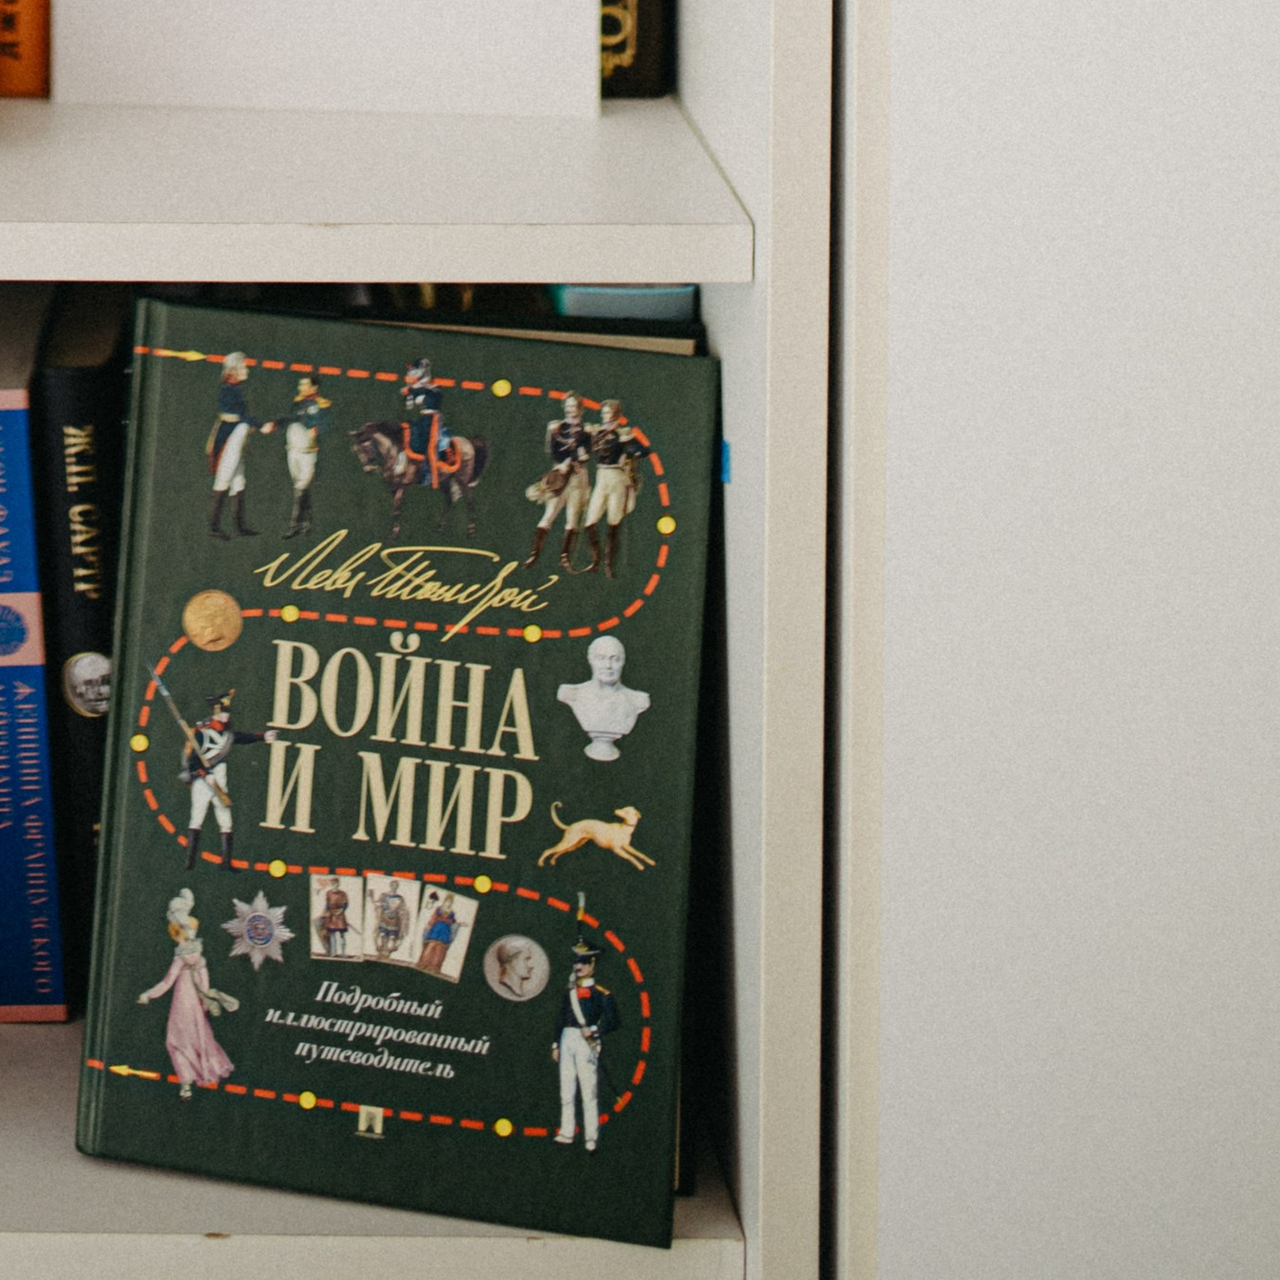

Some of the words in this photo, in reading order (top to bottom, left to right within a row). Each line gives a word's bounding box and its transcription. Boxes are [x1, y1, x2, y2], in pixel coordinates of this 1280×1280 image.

[68, 503, 102, 599] САРТР
[267, 631, 540, 762] ВОЙНА
[259, 741, 320, 835] И
[352, 754, 534, 860] МИР
[264, 1008, 491, 1055] иллюстрированный
[314, 980, 444, 1019] Подробный
[294, 1040, 456, 1079] путеводитель
